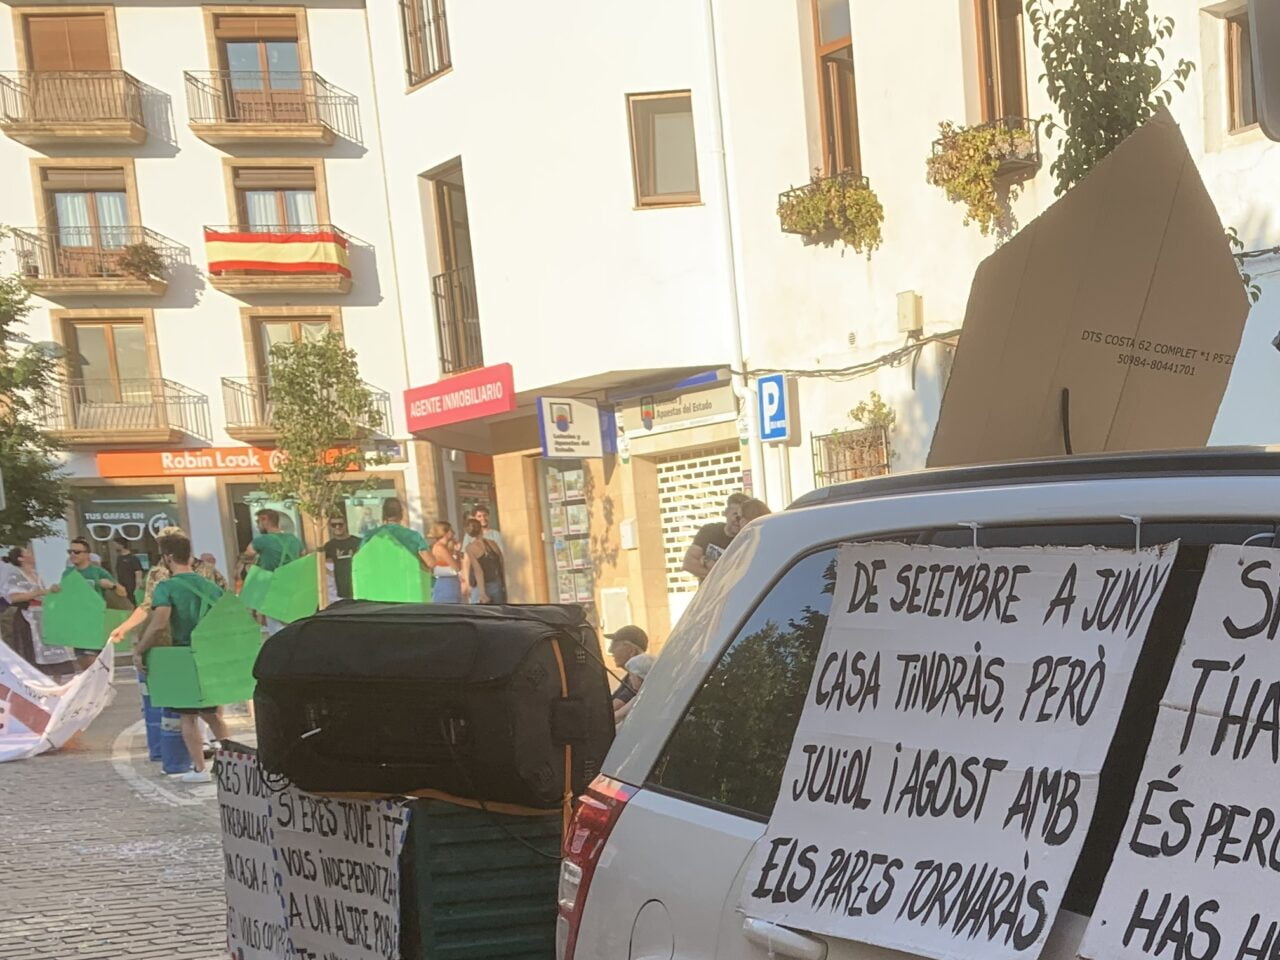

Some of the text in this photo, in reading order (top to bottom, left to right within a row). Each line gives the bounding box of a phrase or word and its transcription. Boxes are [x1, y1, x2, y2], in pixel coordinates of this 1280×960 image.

[1081, 329, 1103, 343] DTS
[1105, 334, 1136, 348] COSTA
[1138, 340, 1152, 352] 62
[1154, 343, 1198, 360] COMPLET
[1117, 353, 1196, 376] 50984-80441701
[410, 381, 504, 418] AGENTE INMOBILIARIO
[762, 381, 780, 435] P
[161, 448, 261, 469] Robin Look
[84, 512, 102, 520] TUS
[132, 511, 145, 520] EN
[847, 558, 888, 614] DE
[1042, 562, 1079, 628] A
[1081, 562, 1172, 639] JUNY
[815, 649, 881, 714] CASA
[1019, 644, 1107, 728] PERÒ
[220, 803, 271, 847] TREBALLAR
[899, 749, 1010, 824] AGOST
[1002, 766, 1082, 847] AMB
[1128, 764, 1195, 858] ÉS
[298, 794, 338, 837] ERES
[338, 801, 375, 849] JOVE
[383, 814, 404, 859] ET
[280, 846, 318, 882] VOLS
[288, 892, 305, 929] A
[305, 893, 332, 936] UN
[334, 898, 373, 951] ALTRE
[751, 837, 1050, 952] ELS PARES TORNARÀS
